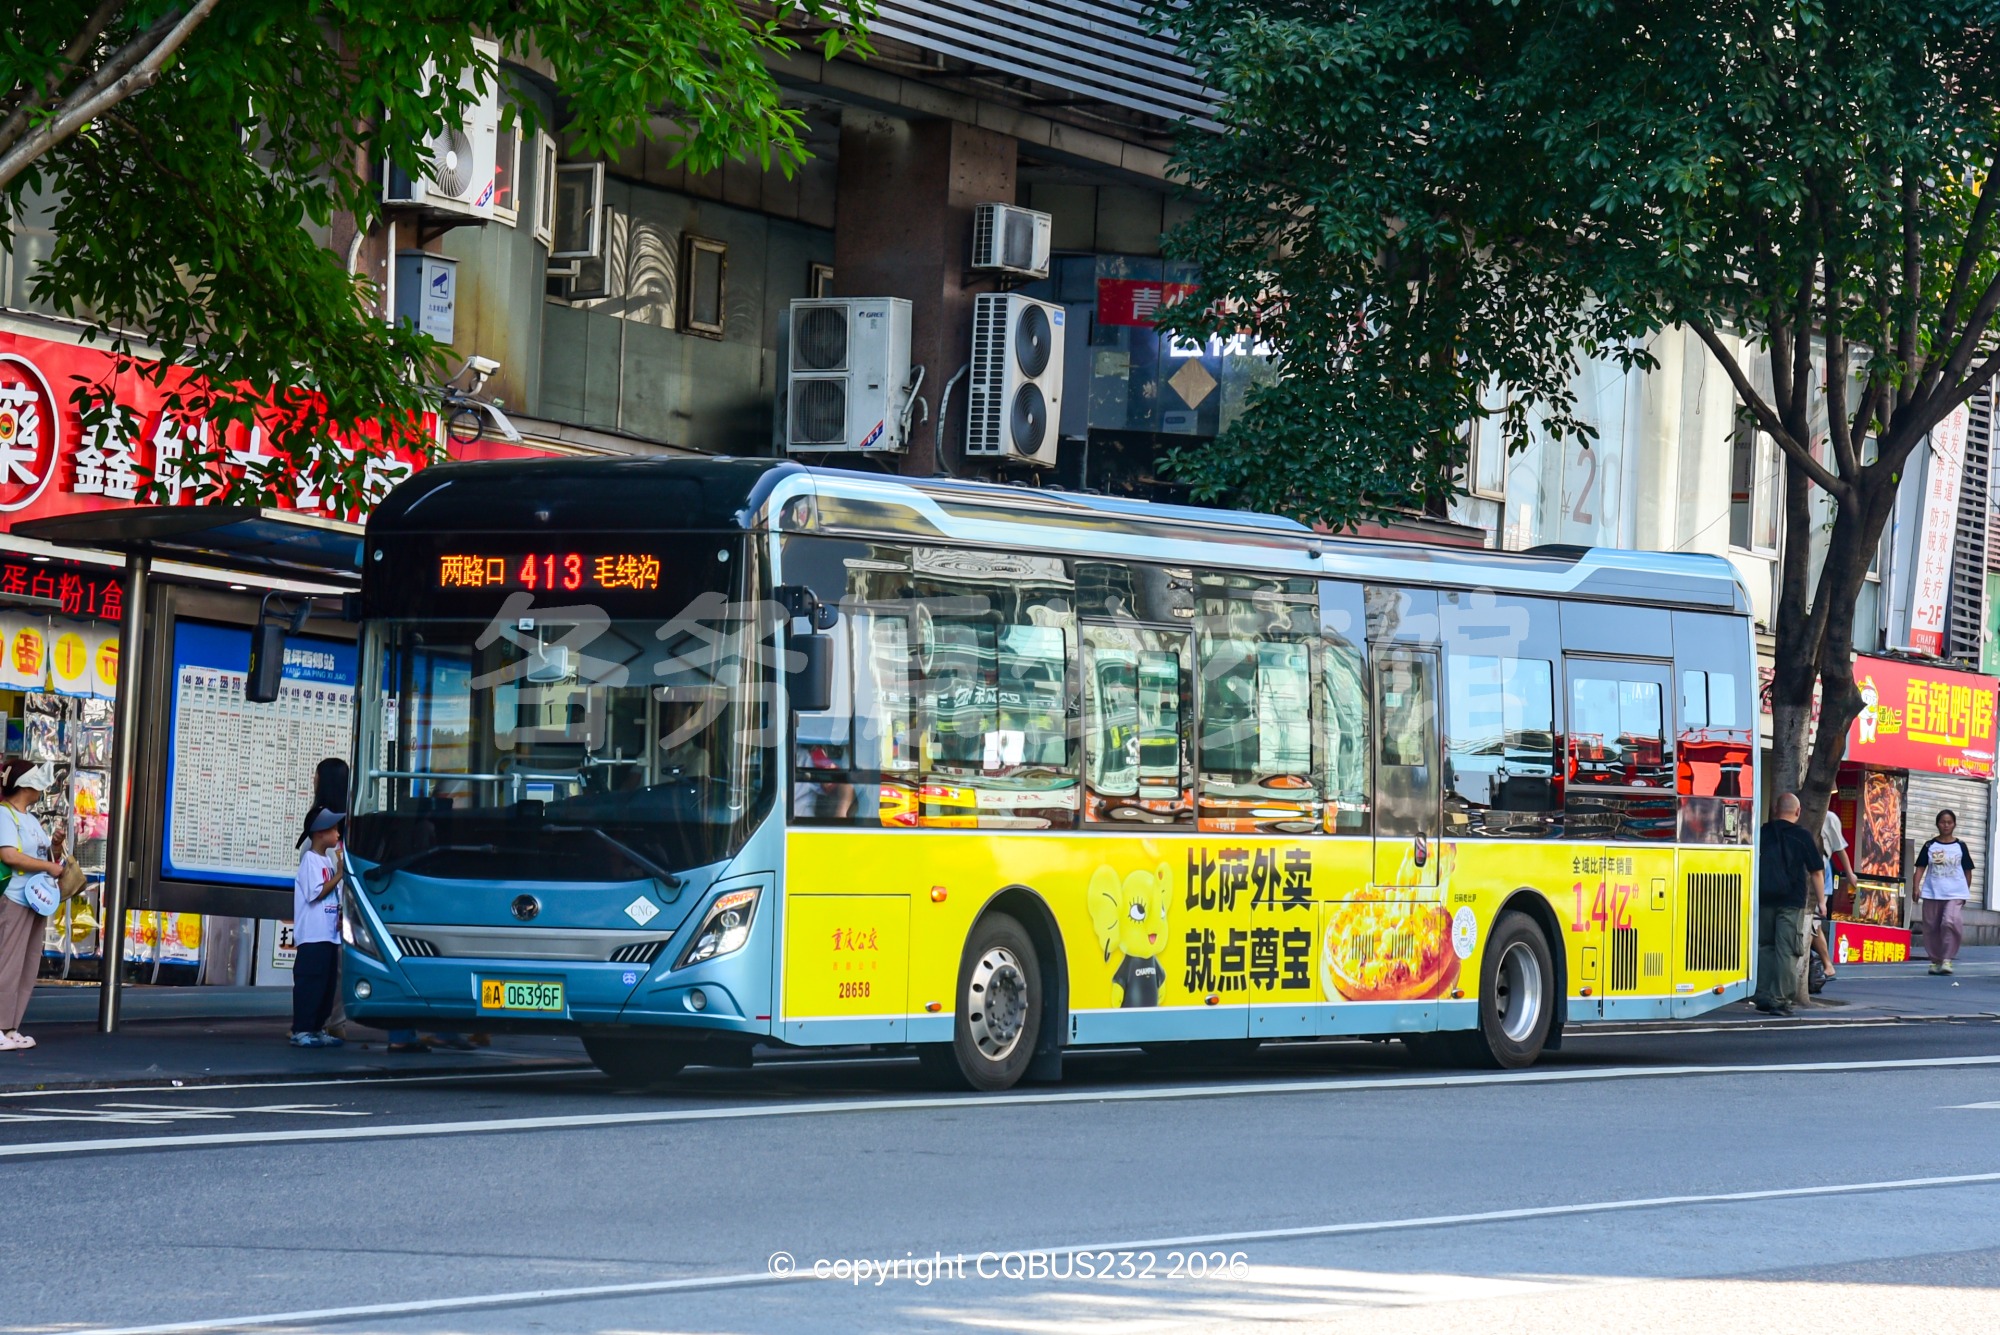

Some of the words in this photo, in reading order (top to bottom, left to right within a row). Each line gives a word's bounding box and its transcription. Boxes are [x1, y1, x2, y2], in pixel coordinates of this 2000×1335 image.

[440, 554, 504, 588] 两路口
[519, 553, 583, 590] 413
[593, 554, 660, 589] 毛线沟
[1927, 604, 1943, 626] 2F
[1916, 633, 1936, 646] CHAFA
[1185, 847, 1313, 913] 比萨外卖
[630, 904, 653, 918] CNG
[831, 927, 879, 952] 重庆公交
[1183, 926, 1312, 994] 就点尊宝
[483, 985, 501, 1005] 渝A
[507, 986, 560, 1007] 06396F
[839, 981, 870, 999] 28658
